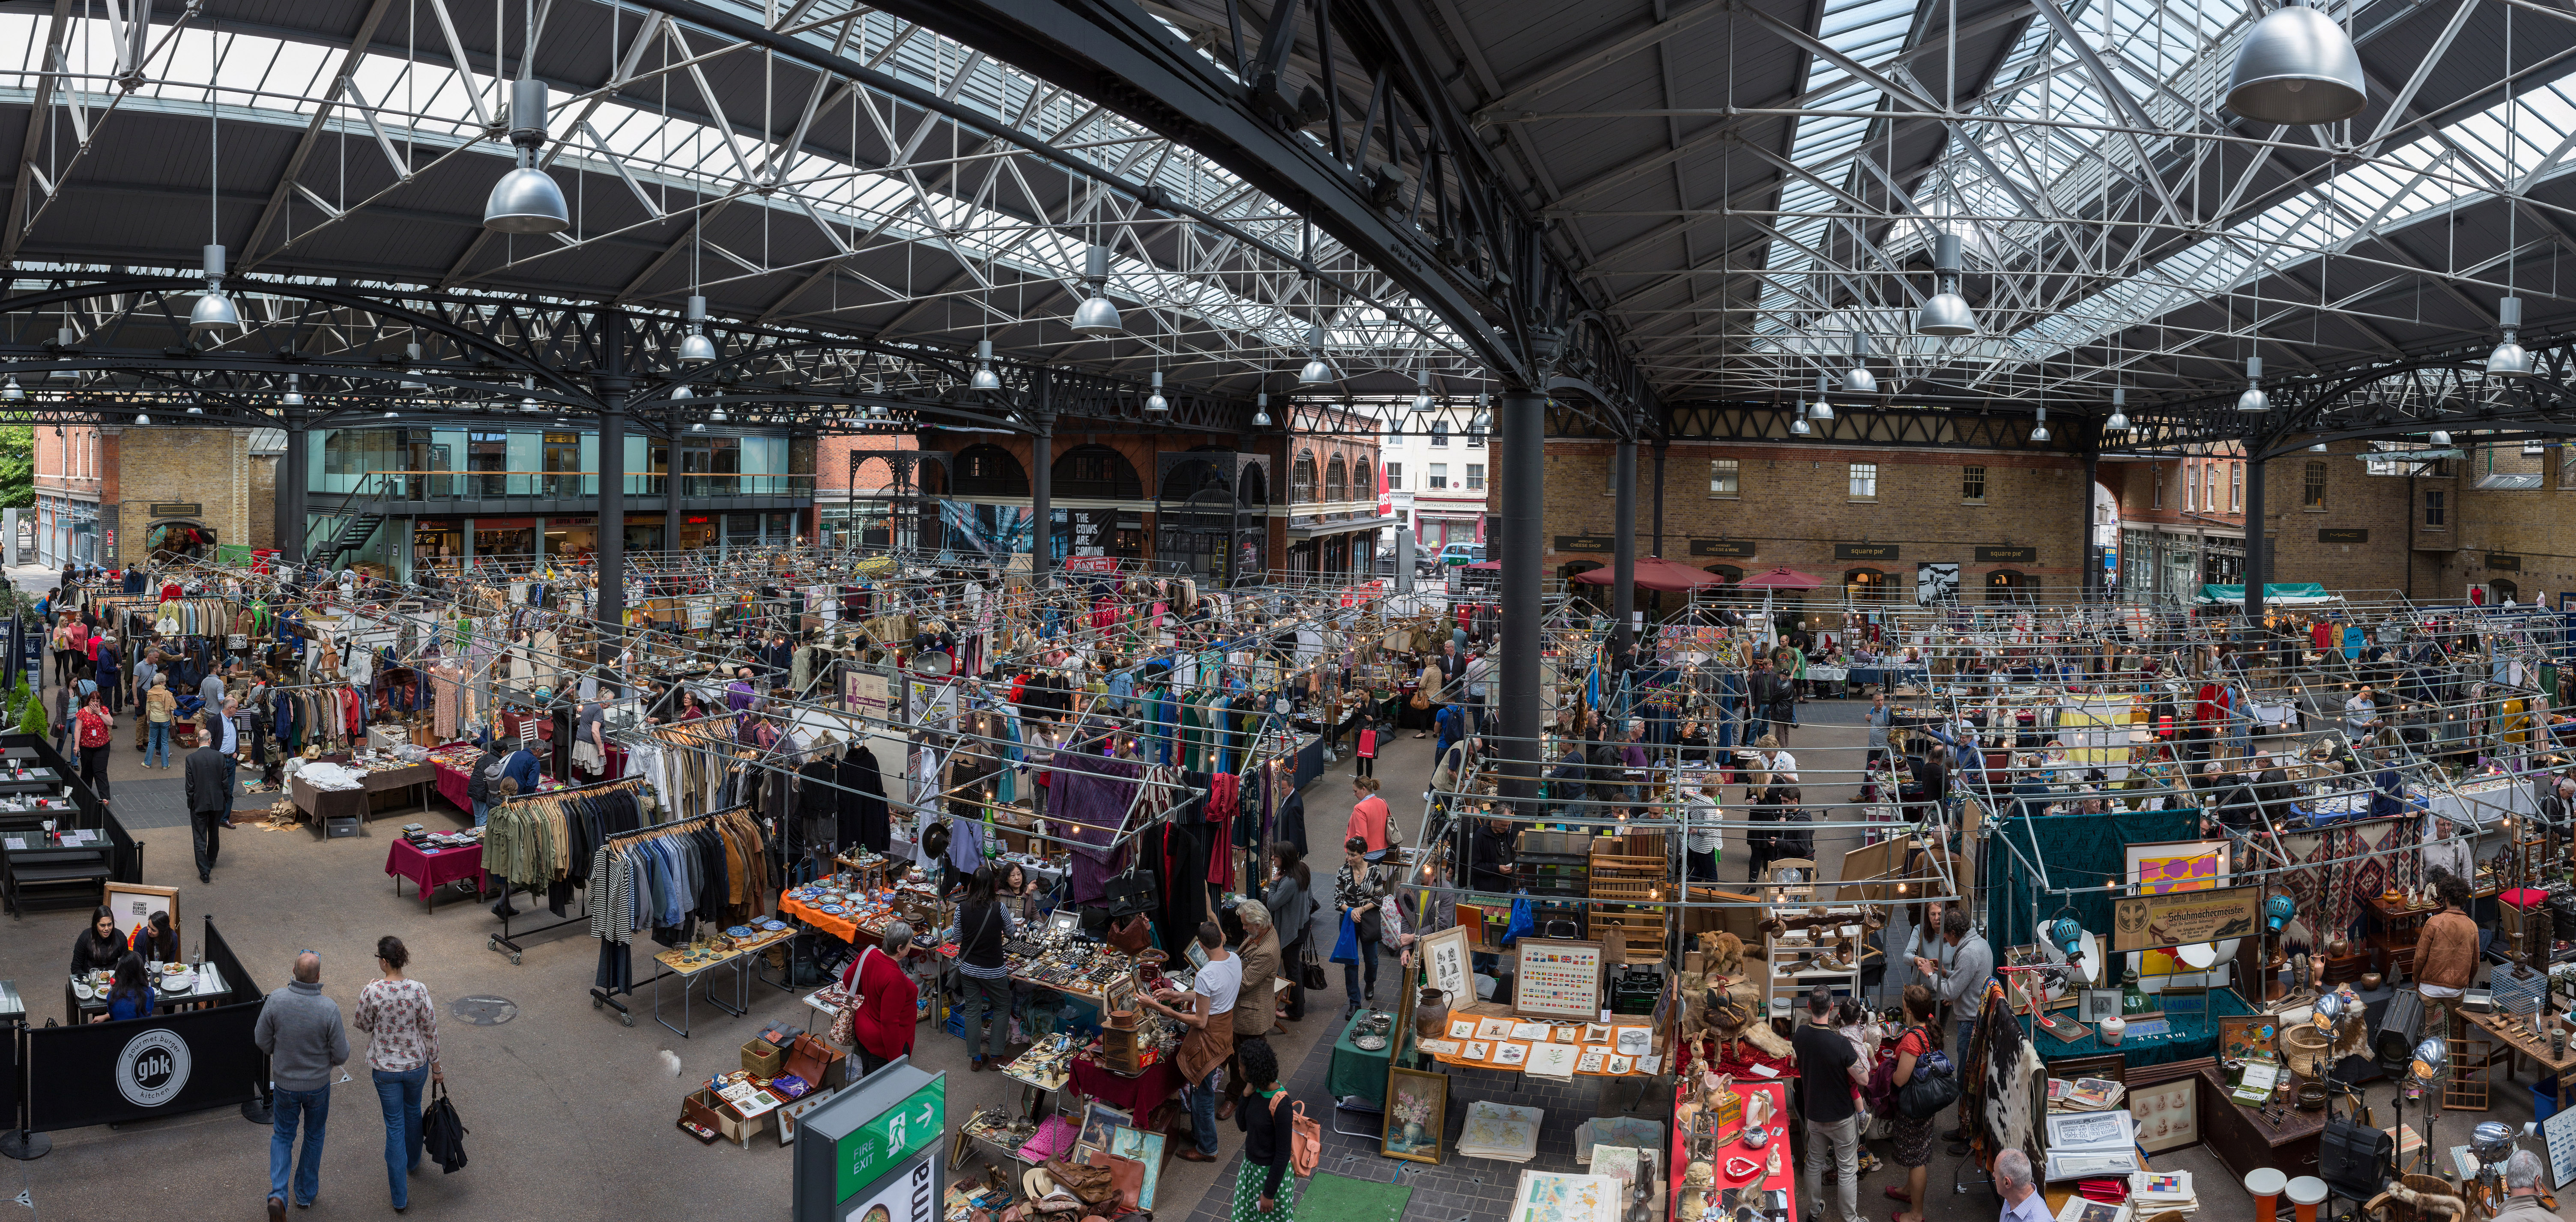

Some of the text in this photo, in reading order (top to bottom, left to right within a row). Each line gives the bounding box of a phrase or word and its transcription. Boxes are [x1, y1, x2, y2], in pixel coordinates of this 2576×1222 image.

[1076, 513, 1088, 523] THE
[1076, 524, 1098, 534] COWS
[1075, 535, 1089, 545] ARE
[1076, 546, 1104, 556] COMING
[2189, 893, 2202, 902] dem
[2168, 906, 2244, 922] Schuhmachermeister
[2164, 999, 2201, 1010] LADIES
[2128, 1022, 2164, 1034] GENTS
[129, 1035, 180, 1059] gourmet burger
[138, 1055, 170, 1081] gbk
[140, 1088, 170, 1098] kitchen
[1721, 1111, 1739, 1123] TOBACCO
[854, 1138, 874, 1160] FIRE
[854, 1152, 874, 1175] EXIT
[2135, 1173, 2145, 1198] Mondrian
